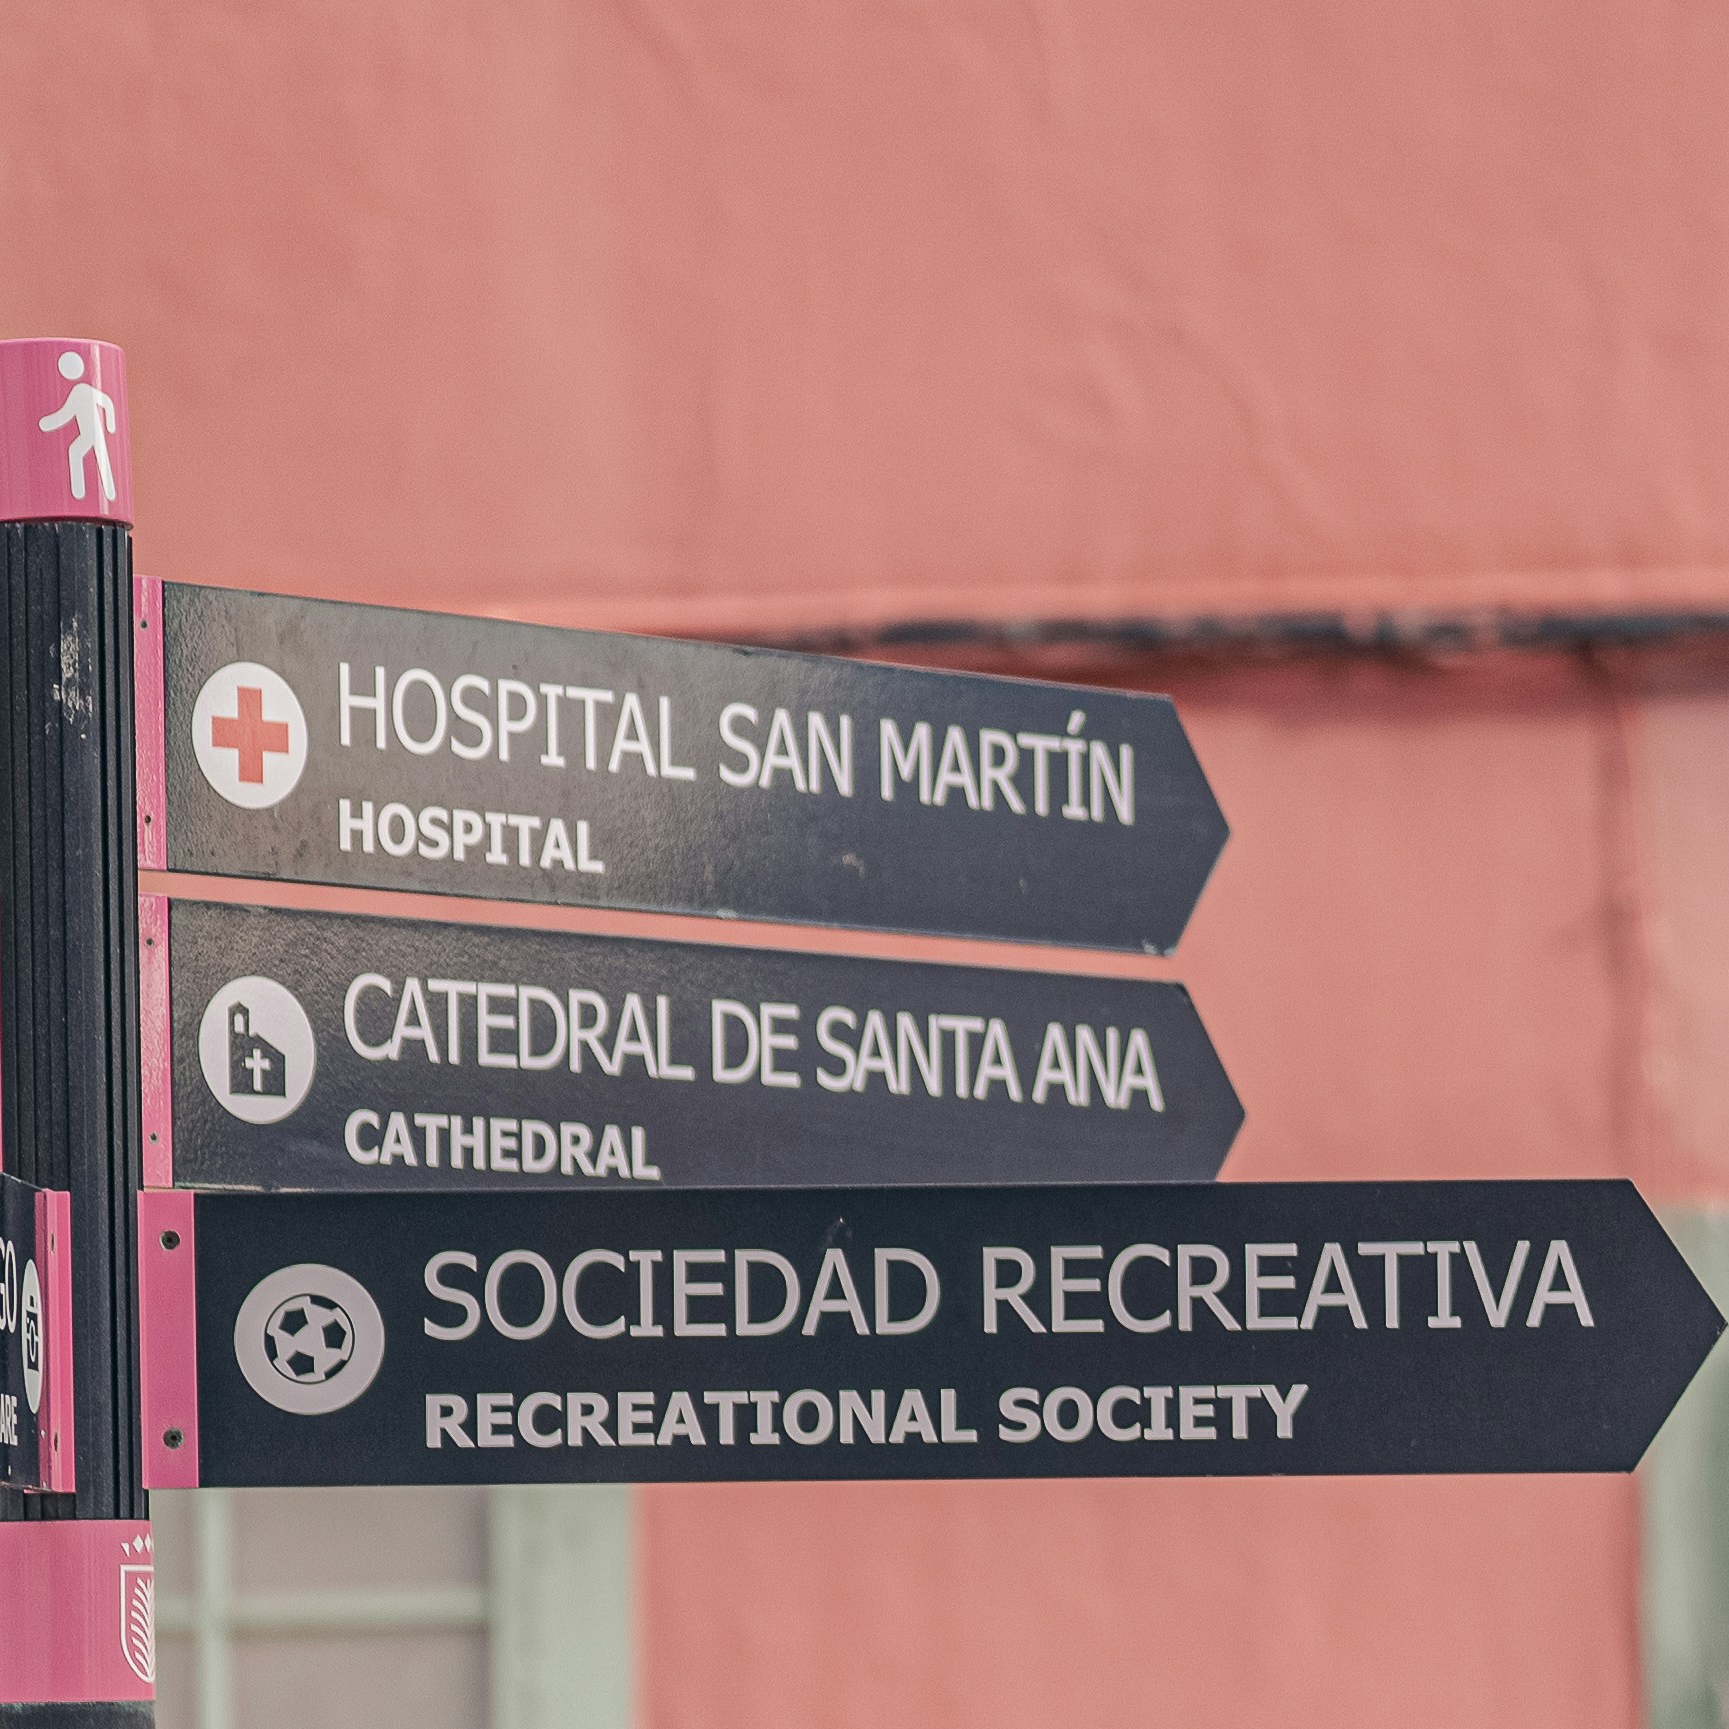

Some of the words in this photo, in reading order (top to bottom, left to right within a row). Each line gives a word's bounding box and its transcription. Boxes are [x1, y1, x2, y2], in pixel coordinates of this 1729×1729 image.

[340, 663, 695, 780] HOSPITAL
[719, 702, 851, 796] SAN
[880, 711, 1133, 824] MARTÍN
[340, 799, 604, 873] HOSPITAL
[344, 972, 694, 1080] CATEDRAL
[712, 999, 800, 1087] DE
[817, 1007, 1022, 1101] SANTA
[1033, 1023, 1163, 1111] ANA
[345, 1110, 660, 1180] CATHEDRAL
[424, 1248, 940, 1340] SOCIEDAD
[983, 1240, 1594, 1333] RECREATIVA
[426, 1389, 977, 1448] RECREATIONAL
[999, 1384, 1308, 1442] SOCIETY
